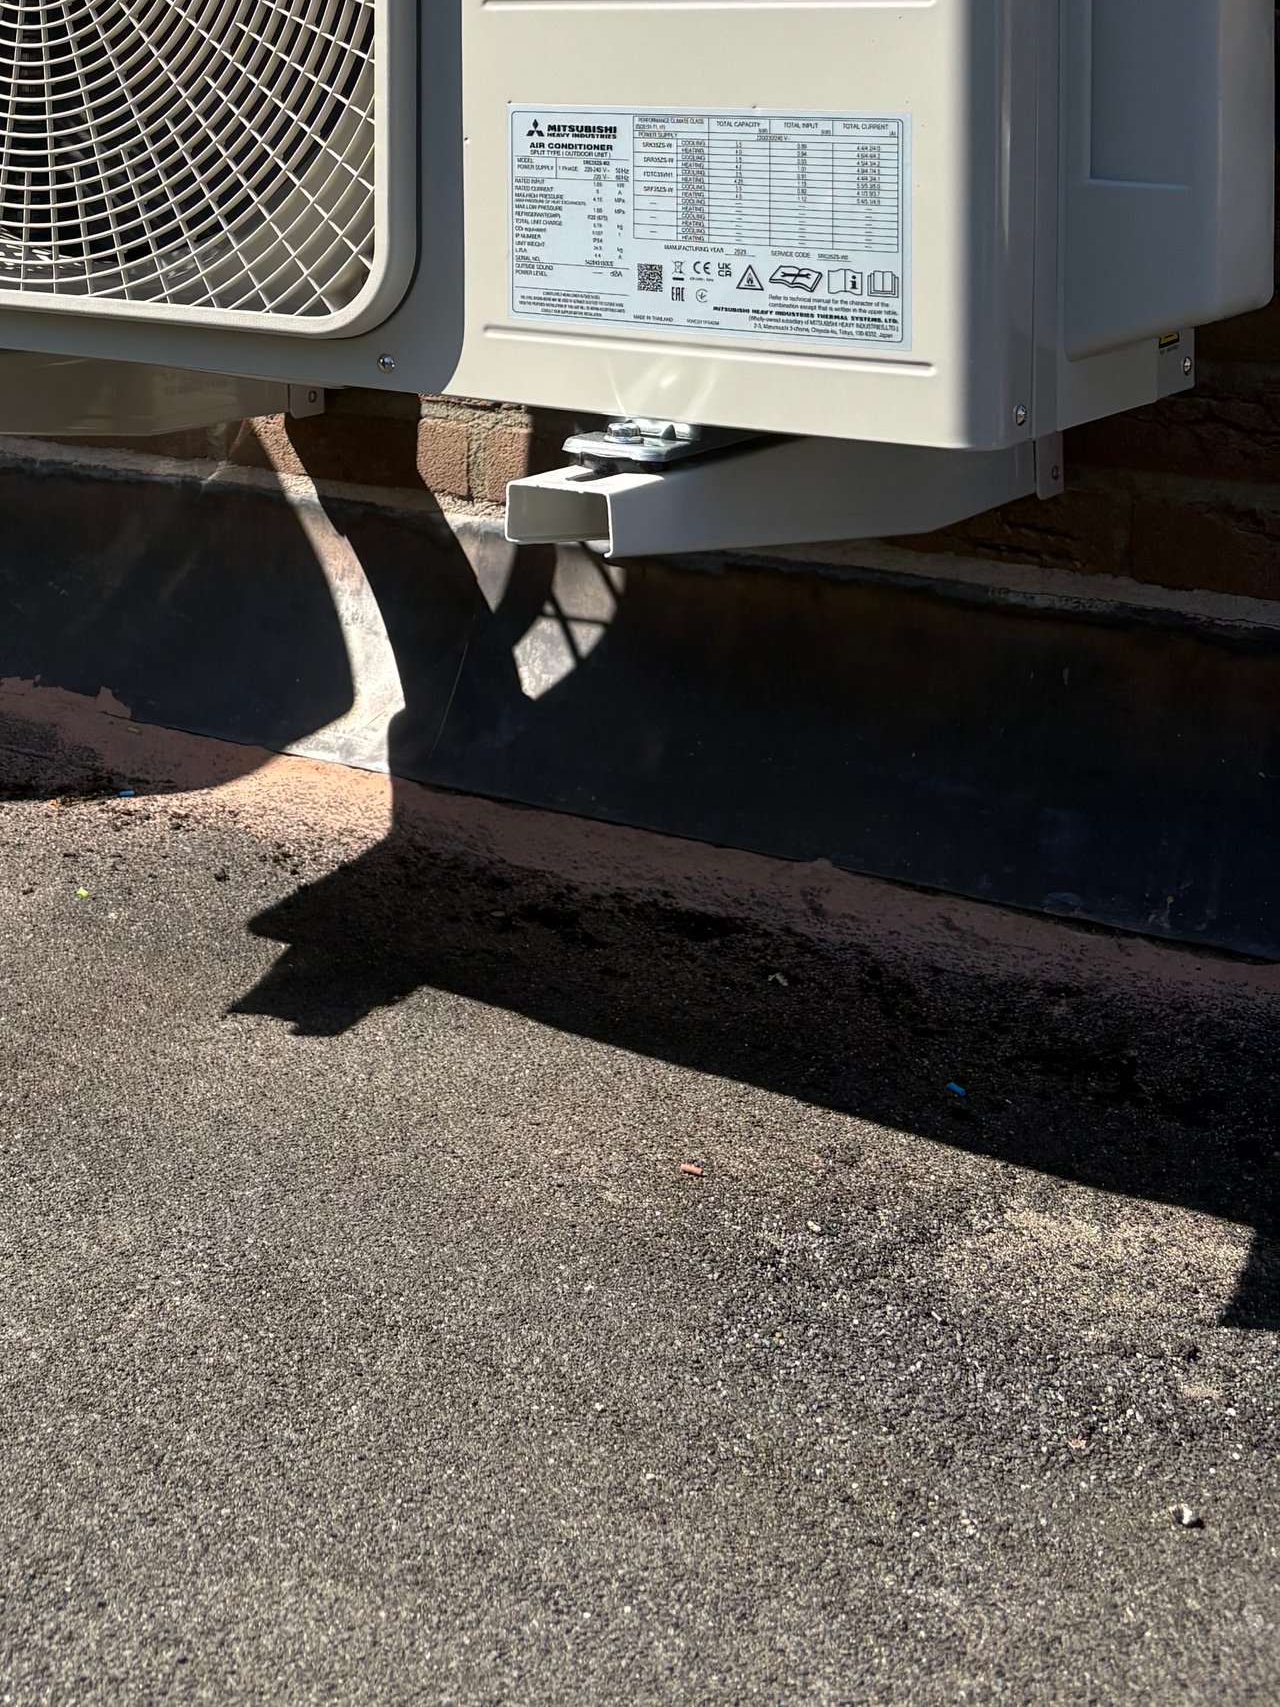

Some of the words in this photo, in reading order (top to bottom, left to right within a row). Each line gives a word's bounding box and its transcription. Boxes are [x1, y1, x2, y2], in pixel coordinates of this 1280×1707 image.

[547, 124, 617, 133] MITSUBISHI
[547, 142, 613, 151] CONDITIONER
[717, 262, 731, 270] UK
